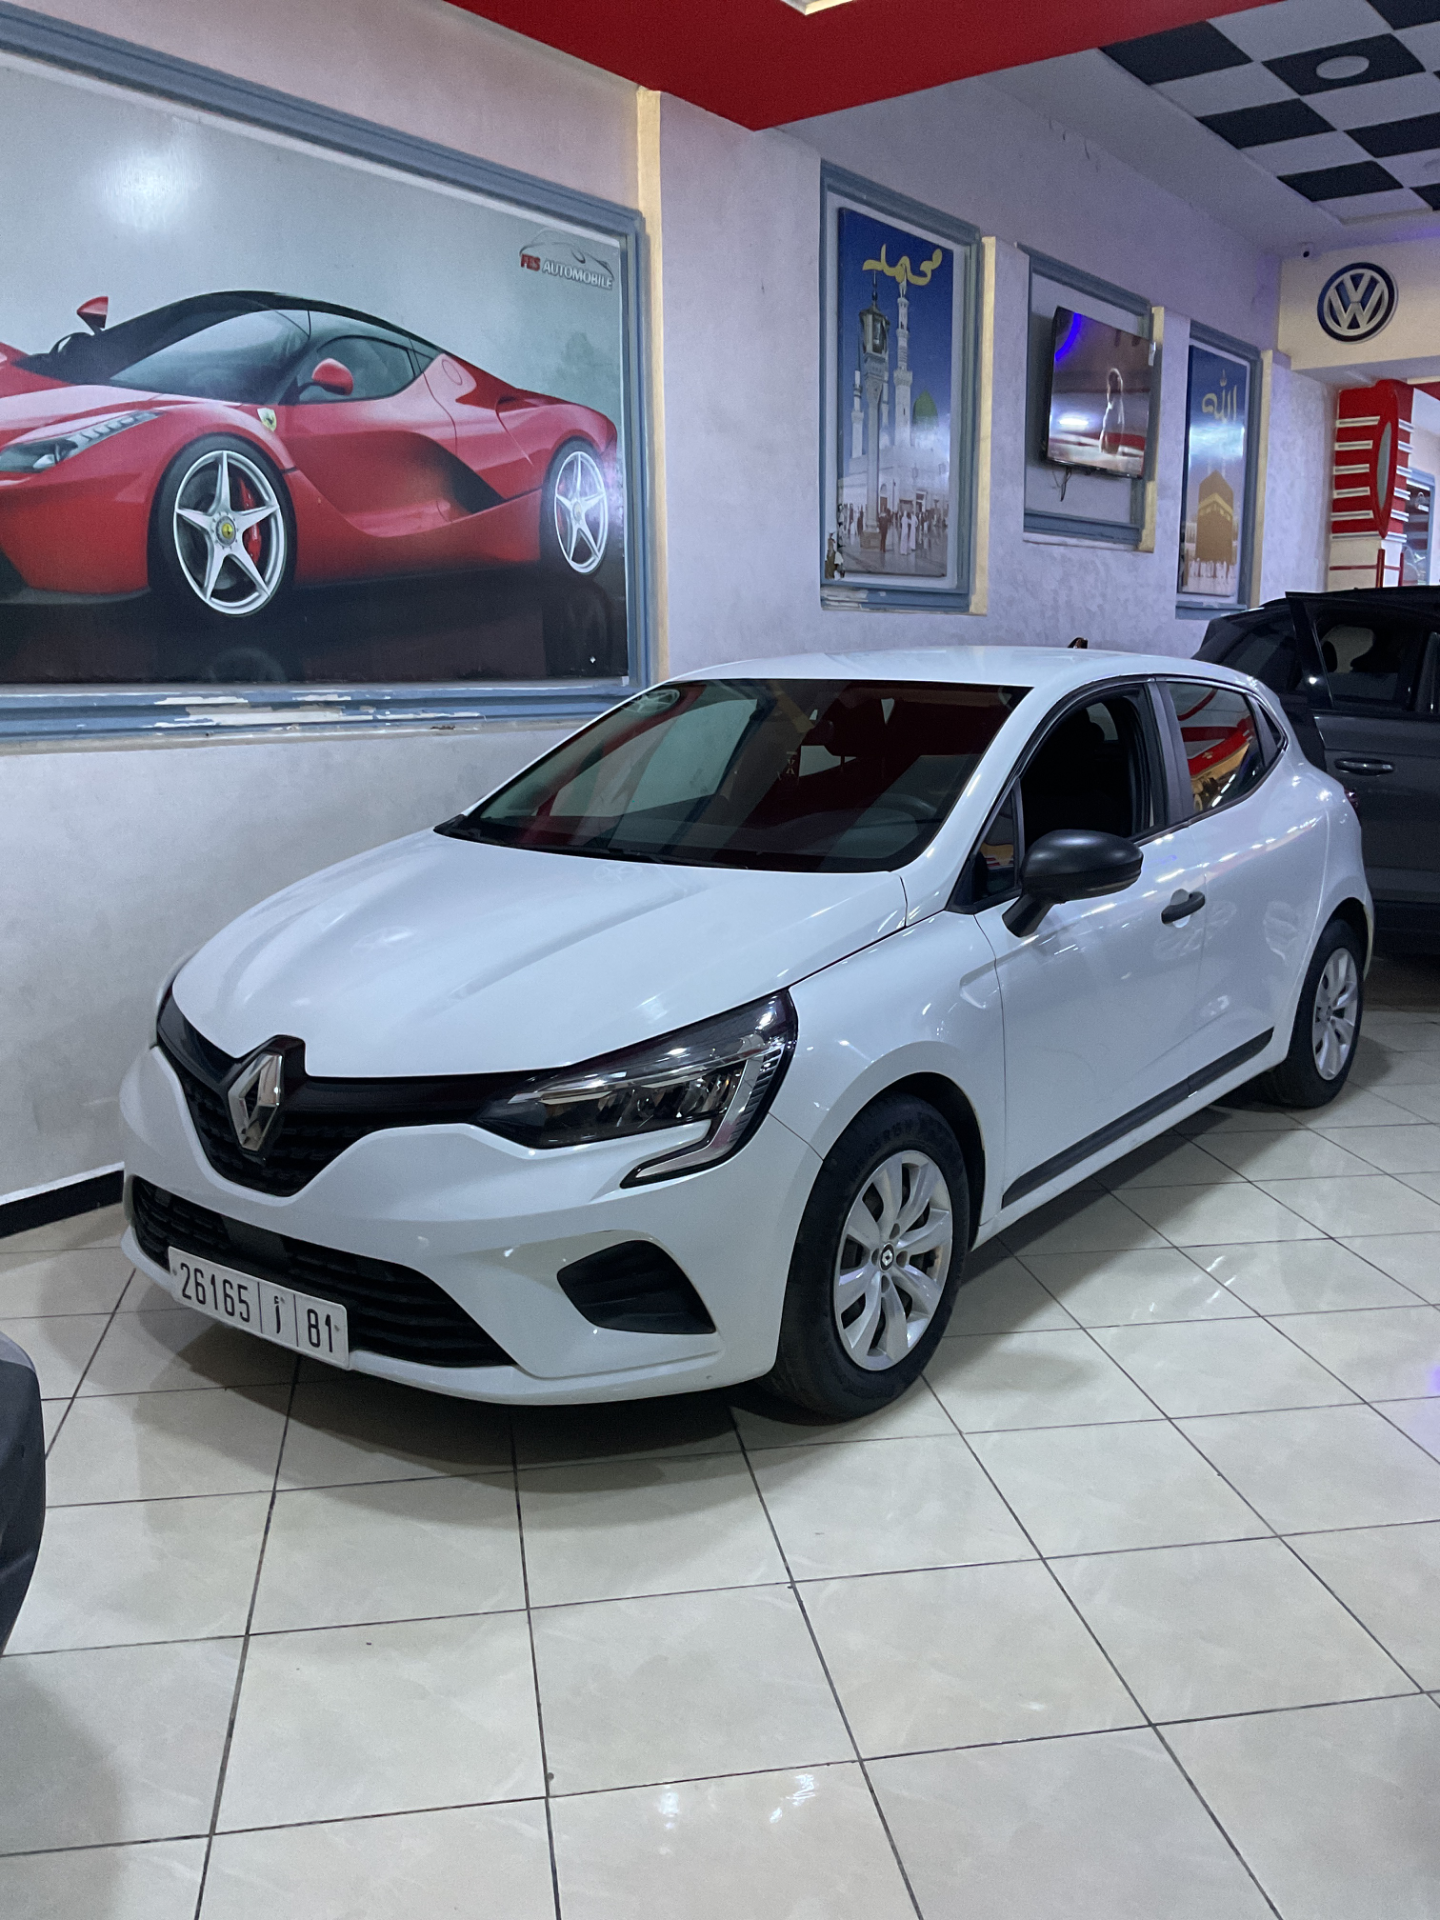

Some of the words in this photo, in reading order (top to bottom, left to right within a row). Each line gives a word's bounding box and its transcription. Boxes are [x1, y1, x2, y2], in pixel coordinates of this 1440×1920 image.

[542, 260, 613, 290] AUTOMOBILE
[862, 243, 943, 286] محمد
[1323, 268, 1390, 336] VW
[180, 1262, 250, 1323] 26165
[306, 1308, 333, 1353] 81
